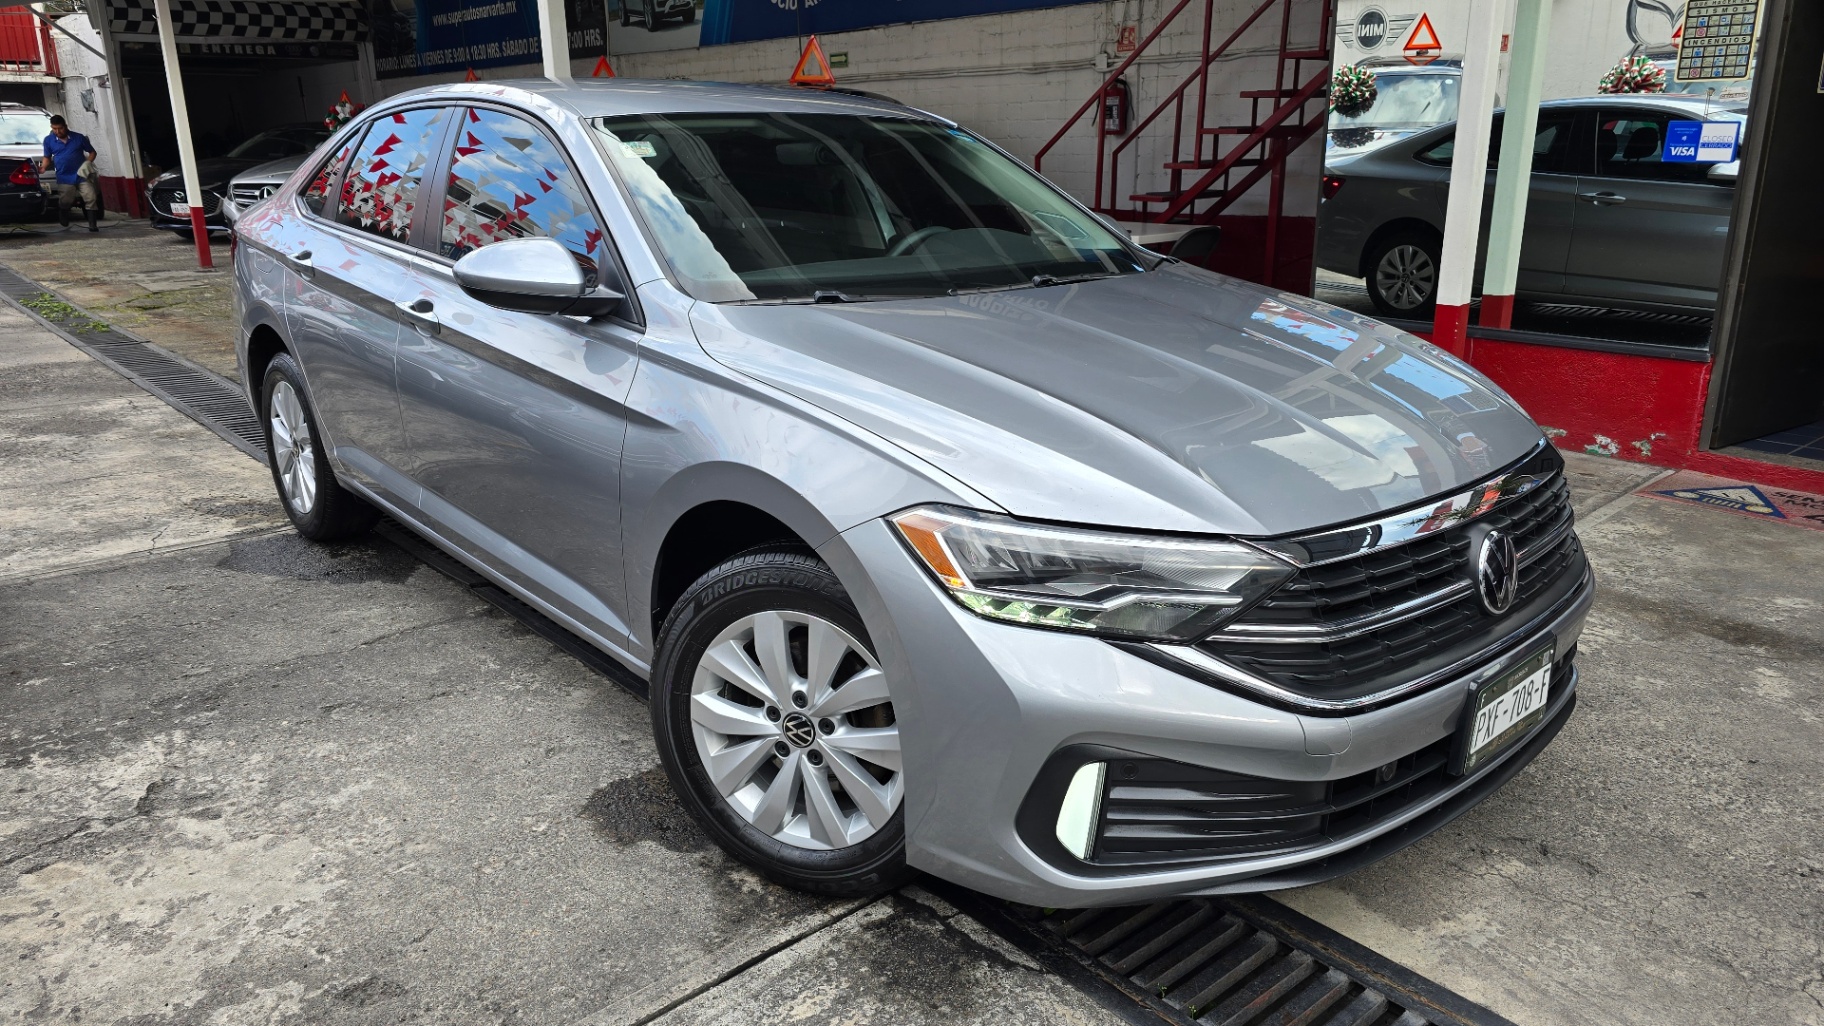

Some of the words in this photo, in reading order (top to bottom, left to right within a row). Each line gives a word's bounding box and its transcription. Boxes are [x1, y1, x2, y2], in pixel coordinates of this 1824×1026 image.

[432, 1, 517, 26] www.superautosnarvarte.mx
[201, 44, 277, 56] ENTREGA
[376, 56, 400, 71] HORARIO:
[400, 54, 417, 69] LUNES
[417, 53, 423, 67] A
[422, 50, 445, 66] VIERNES
[446, 50, 453, 64] DE
[466, 47, 471, 61] A
[471, 44, 487, 60] 18:30
[487, 42, 502, 59] HRS.
[502, 36, 528, 56] SÁBADO
[529, 37, 539, 53] DE
[583, 28, 604, 48] HRS.
[1688, 36, 1747, 46] INCENDIOS
[1670, 147, 1695, 156] VISA
[701, 568, 838, 605] BRIDGESTONE
[1473, 667, 1550, 748] PXF-708-F
